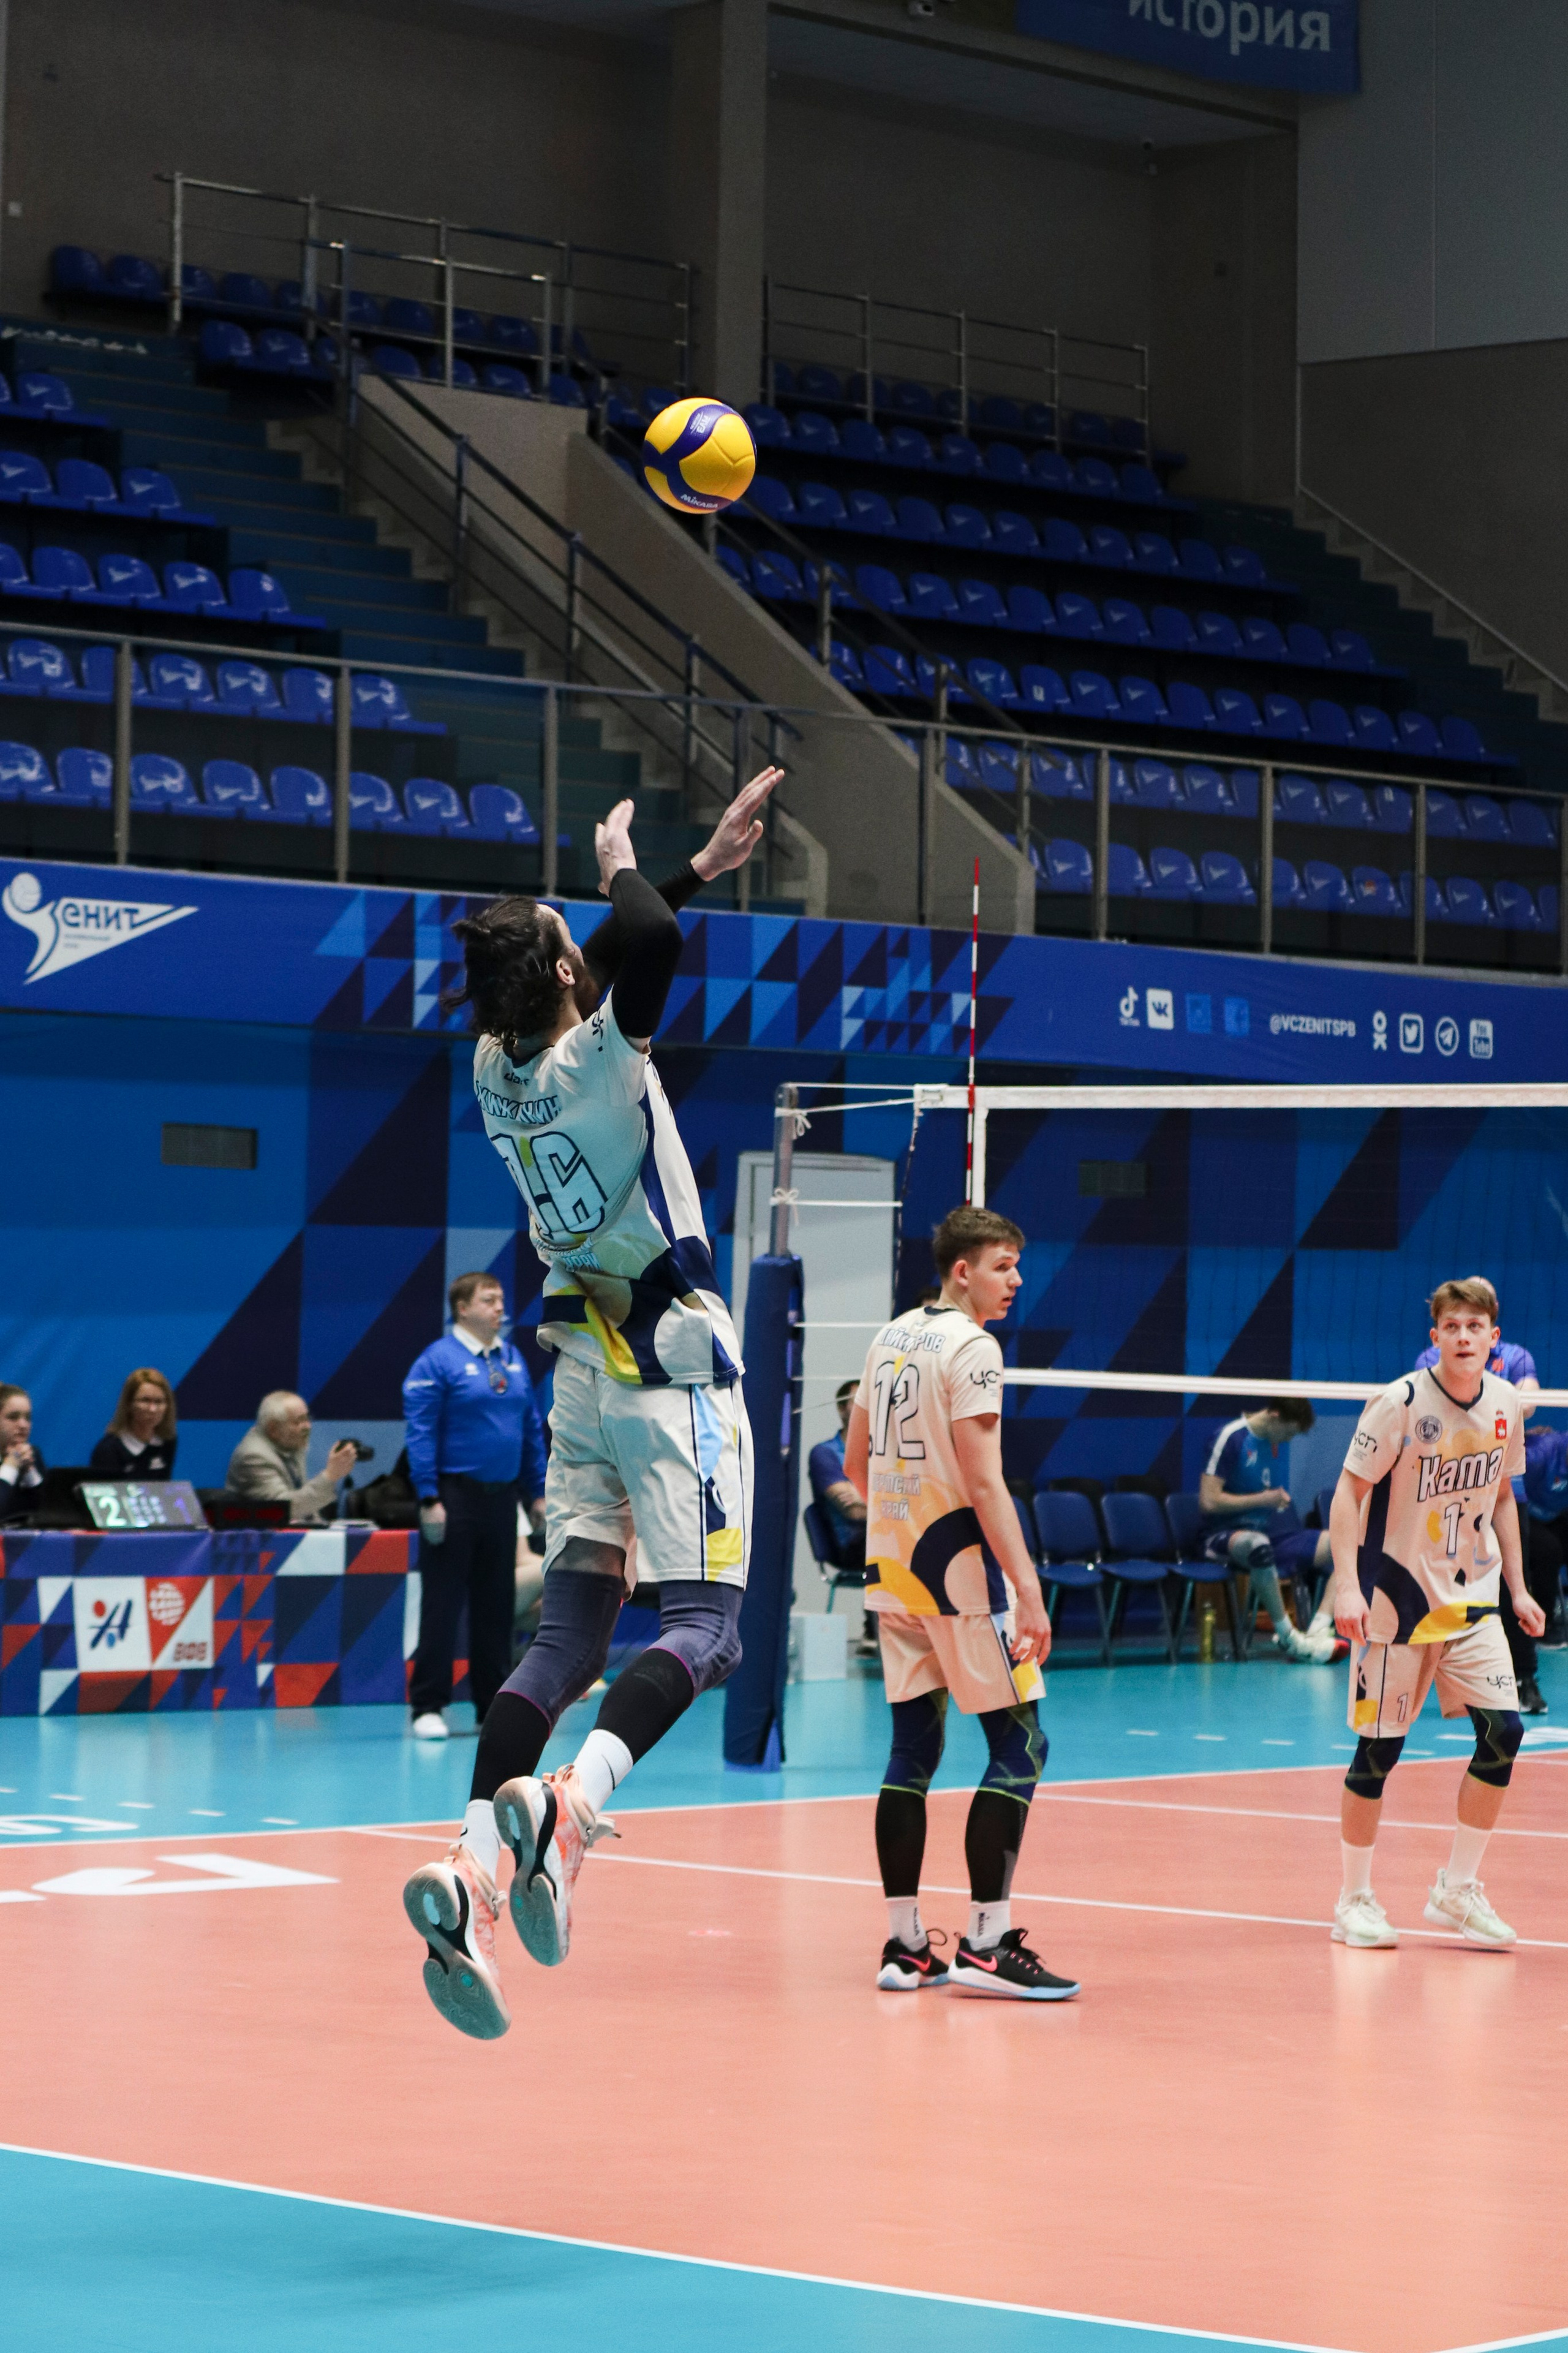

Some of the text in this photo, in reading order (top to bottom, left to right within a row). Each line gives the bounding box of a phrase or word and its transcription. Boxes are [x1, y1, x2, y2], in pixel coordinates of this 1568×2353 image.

[1270, 1014, 1356, 1037] @VCZENITSPB
[875, 1360, 926, 1459] 12
[1417, 1446, 1504, 1503] Kama
[99, 1496, 127, 1527] 2
[1444, 1502, 1461, 1555] 1
[1397, 1693, 1408, 1723] 1
